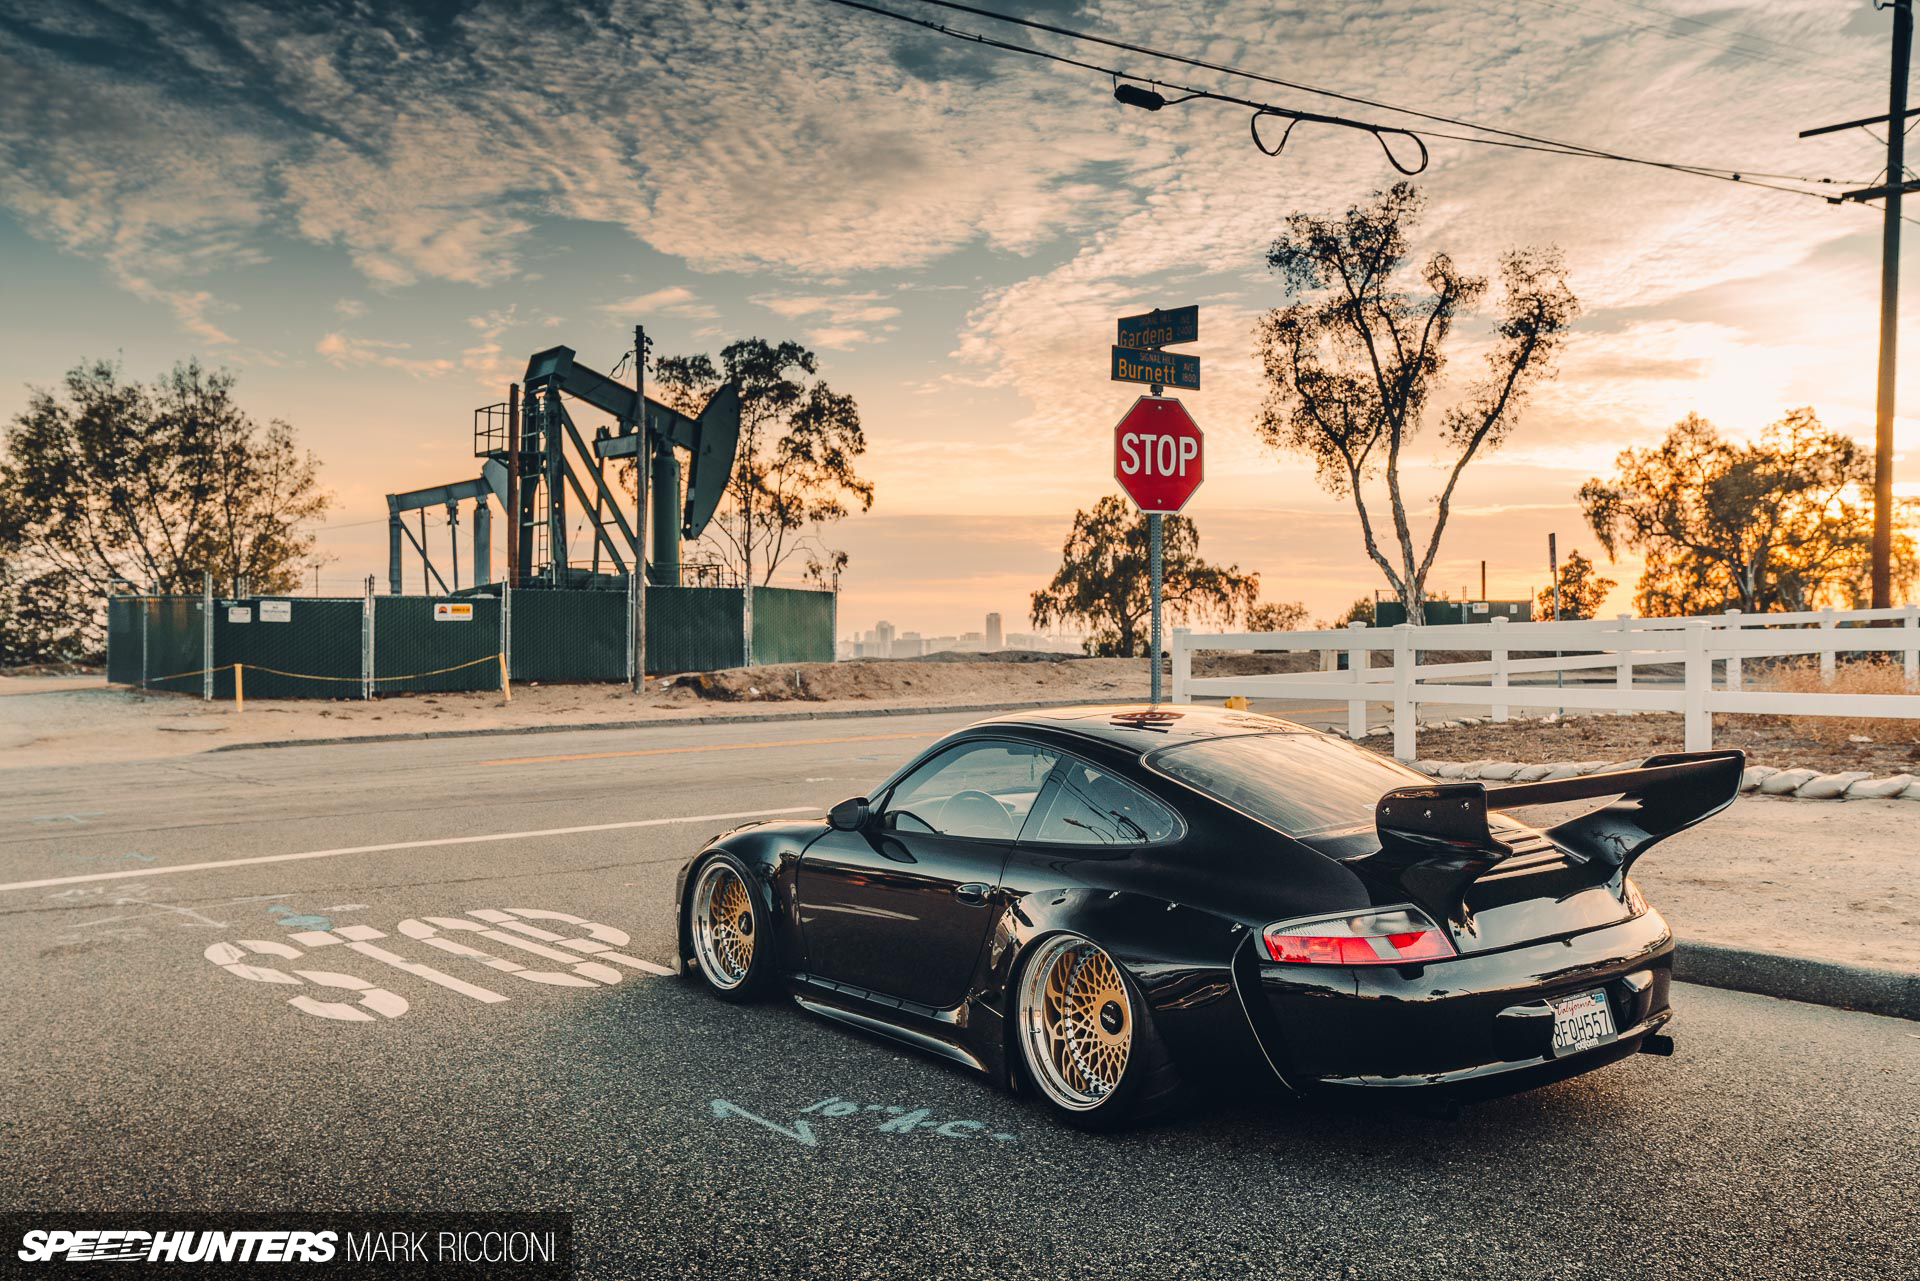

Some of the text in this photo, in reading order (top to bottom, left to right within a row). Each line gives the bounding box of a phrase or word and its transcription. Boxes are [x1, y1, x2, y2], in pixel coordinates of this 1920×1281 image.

[1119, 326, 1173, 347] Gardena
[1118, 358, 1176, 385] Burnett
[1120, 432, 1198, 477] STOP
[204, 908, 678, 1021] STOP
[1557, 999, 1596, 1016] California
